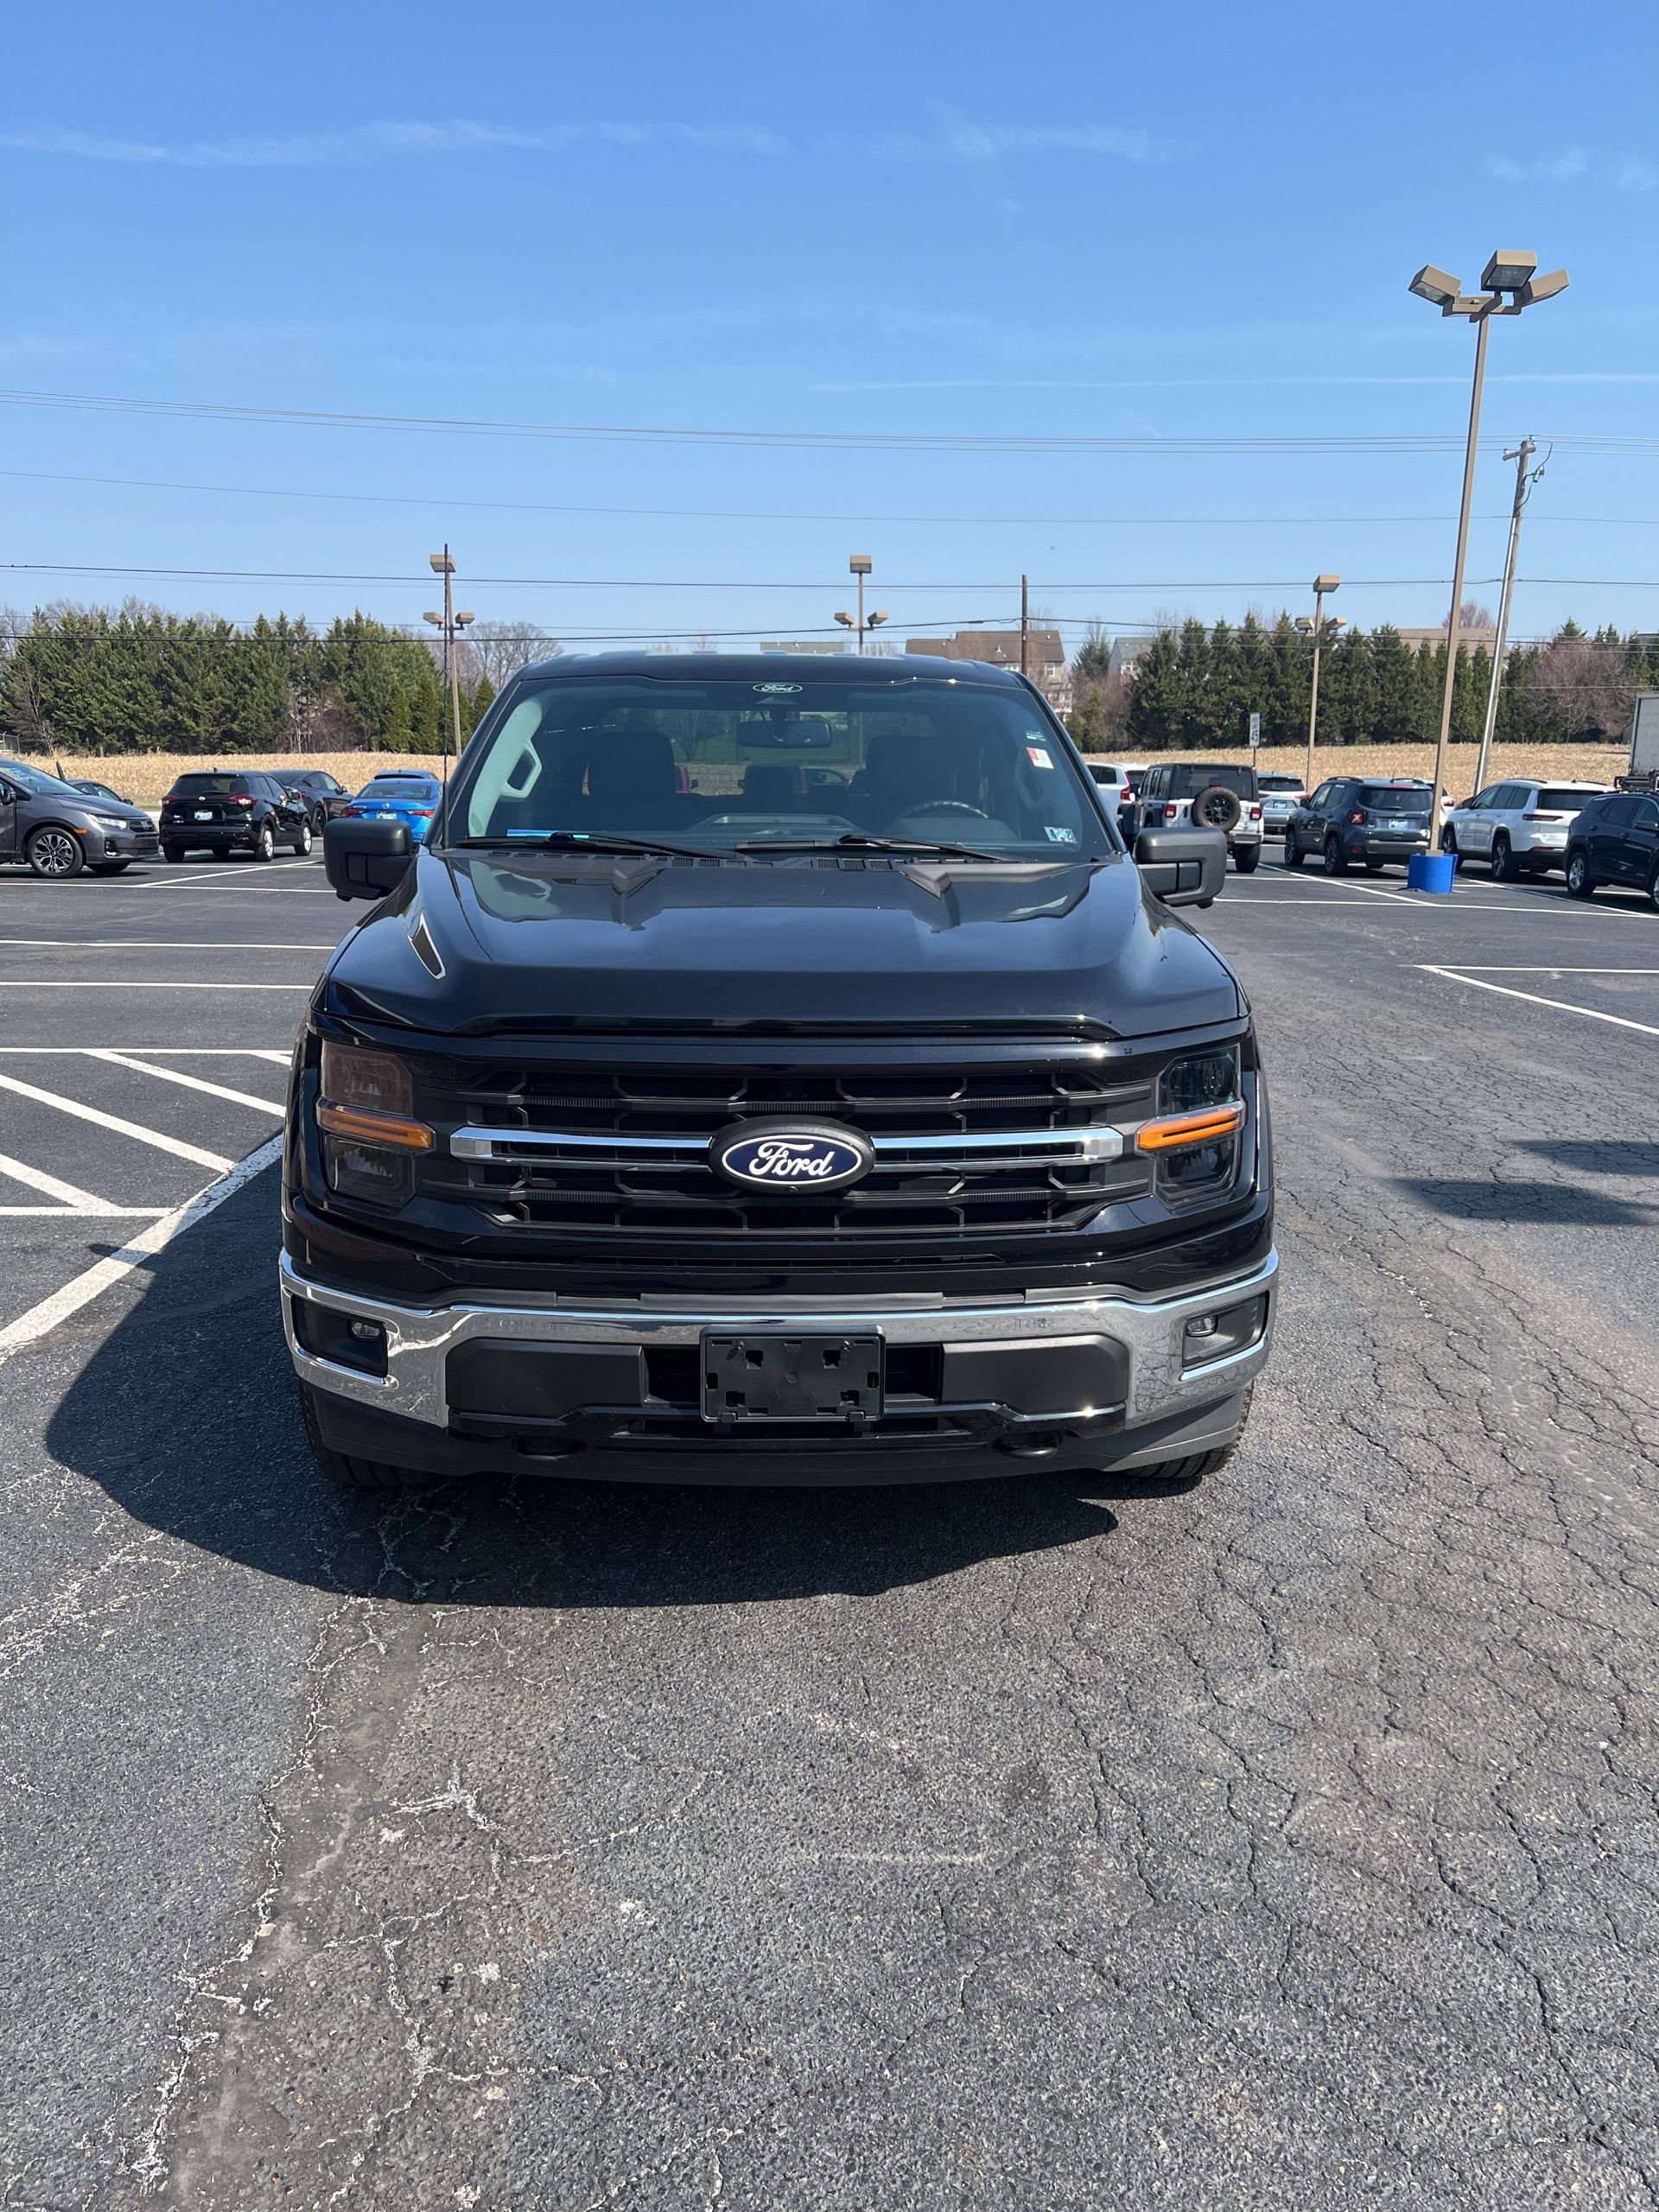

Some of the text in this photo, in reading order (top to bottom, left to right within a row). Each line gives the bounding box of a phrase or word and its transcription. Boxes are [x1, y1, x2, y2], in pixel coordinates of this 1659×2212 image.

[760, 683, 794, 693] Ford
[1250, 729, 1259, 742] 45
[748, 1141, 836, 1176] Ford
